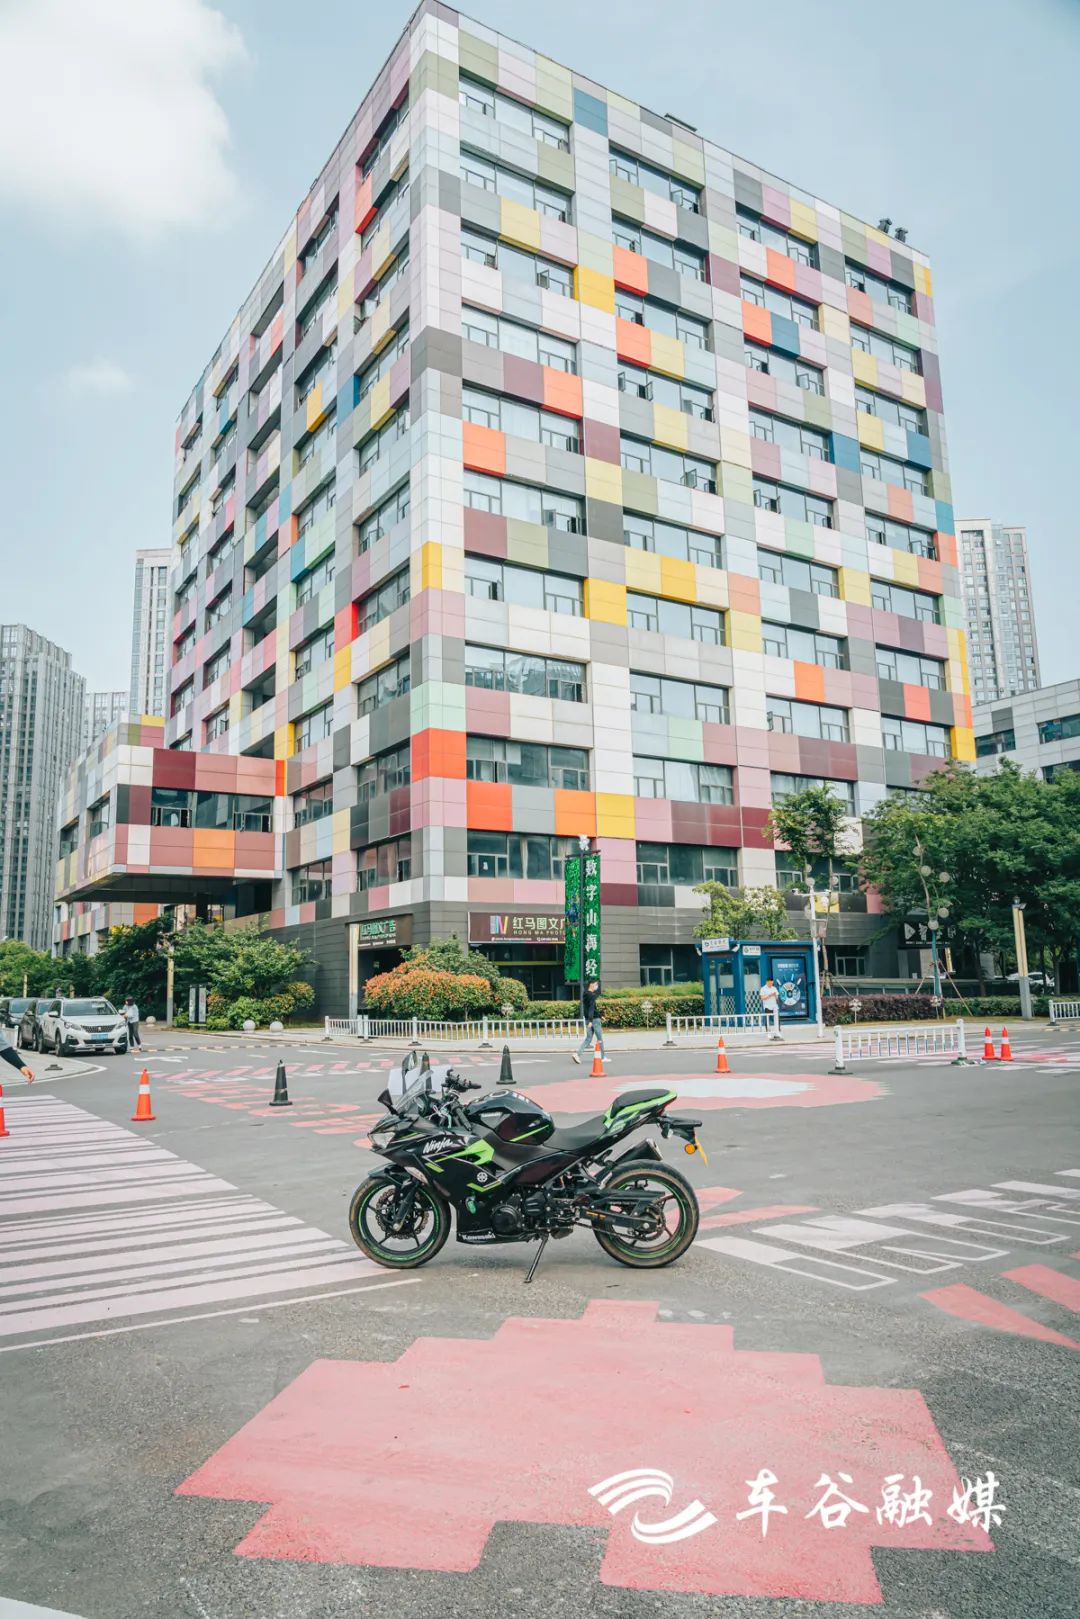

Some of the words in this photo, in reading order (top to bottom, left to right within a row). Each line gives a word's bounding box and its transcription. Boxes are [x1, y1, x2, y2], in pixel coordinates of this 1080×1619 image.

[585, 859, 598, 977] 数字山海经
[422, 1137, 453, 1154] Ninja
